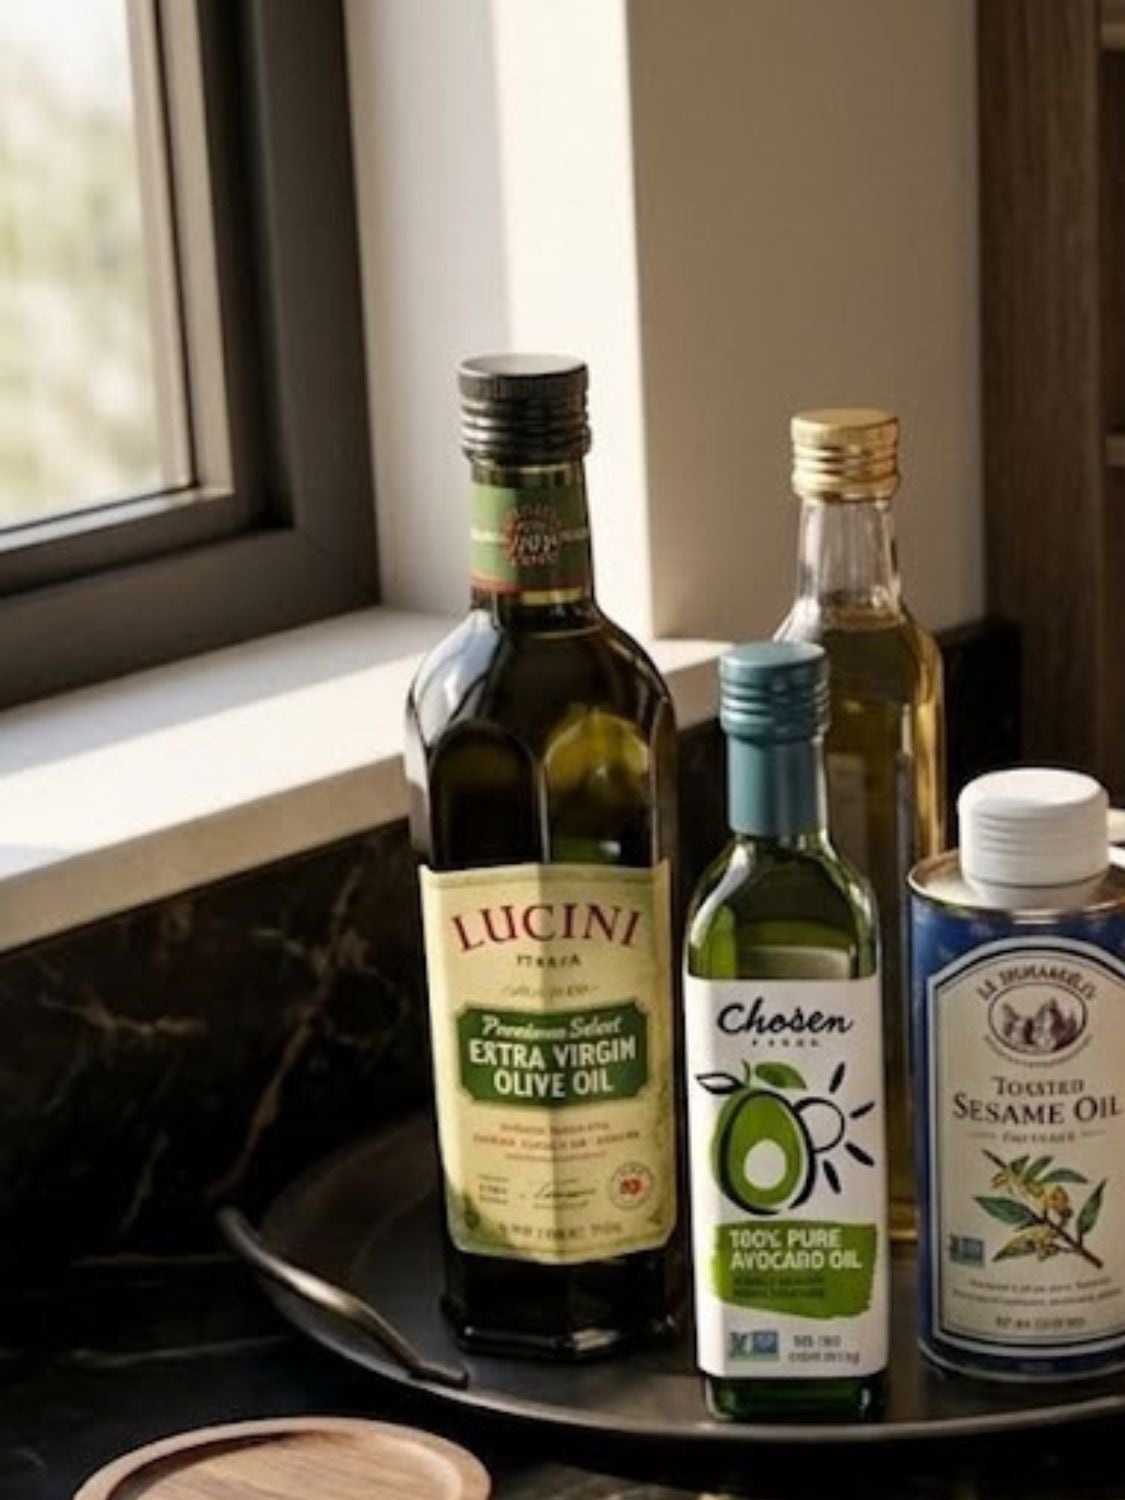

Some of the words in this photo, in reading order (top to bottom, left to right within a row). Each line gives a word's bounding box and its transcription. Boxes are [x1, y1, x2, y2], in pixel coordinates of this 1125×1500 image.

[452, 902, 644, 952] LUCINI
[717, 996, 855, 1035] Chosen
[469, 1039, 546, 1070] EXTRA
[553, 1035, 637, 1068] VIRGIN
[494, 1070, 566, 1098] OLIVE
[572, 1068, 615, 1095] OIL
[729, 1229, 783, 1248] 100%
[787, 1228, 843, 1248] PURE
[731, 1250, 825, 1271] AVOCADO
[829, 1250, 863, 1269] OIL
